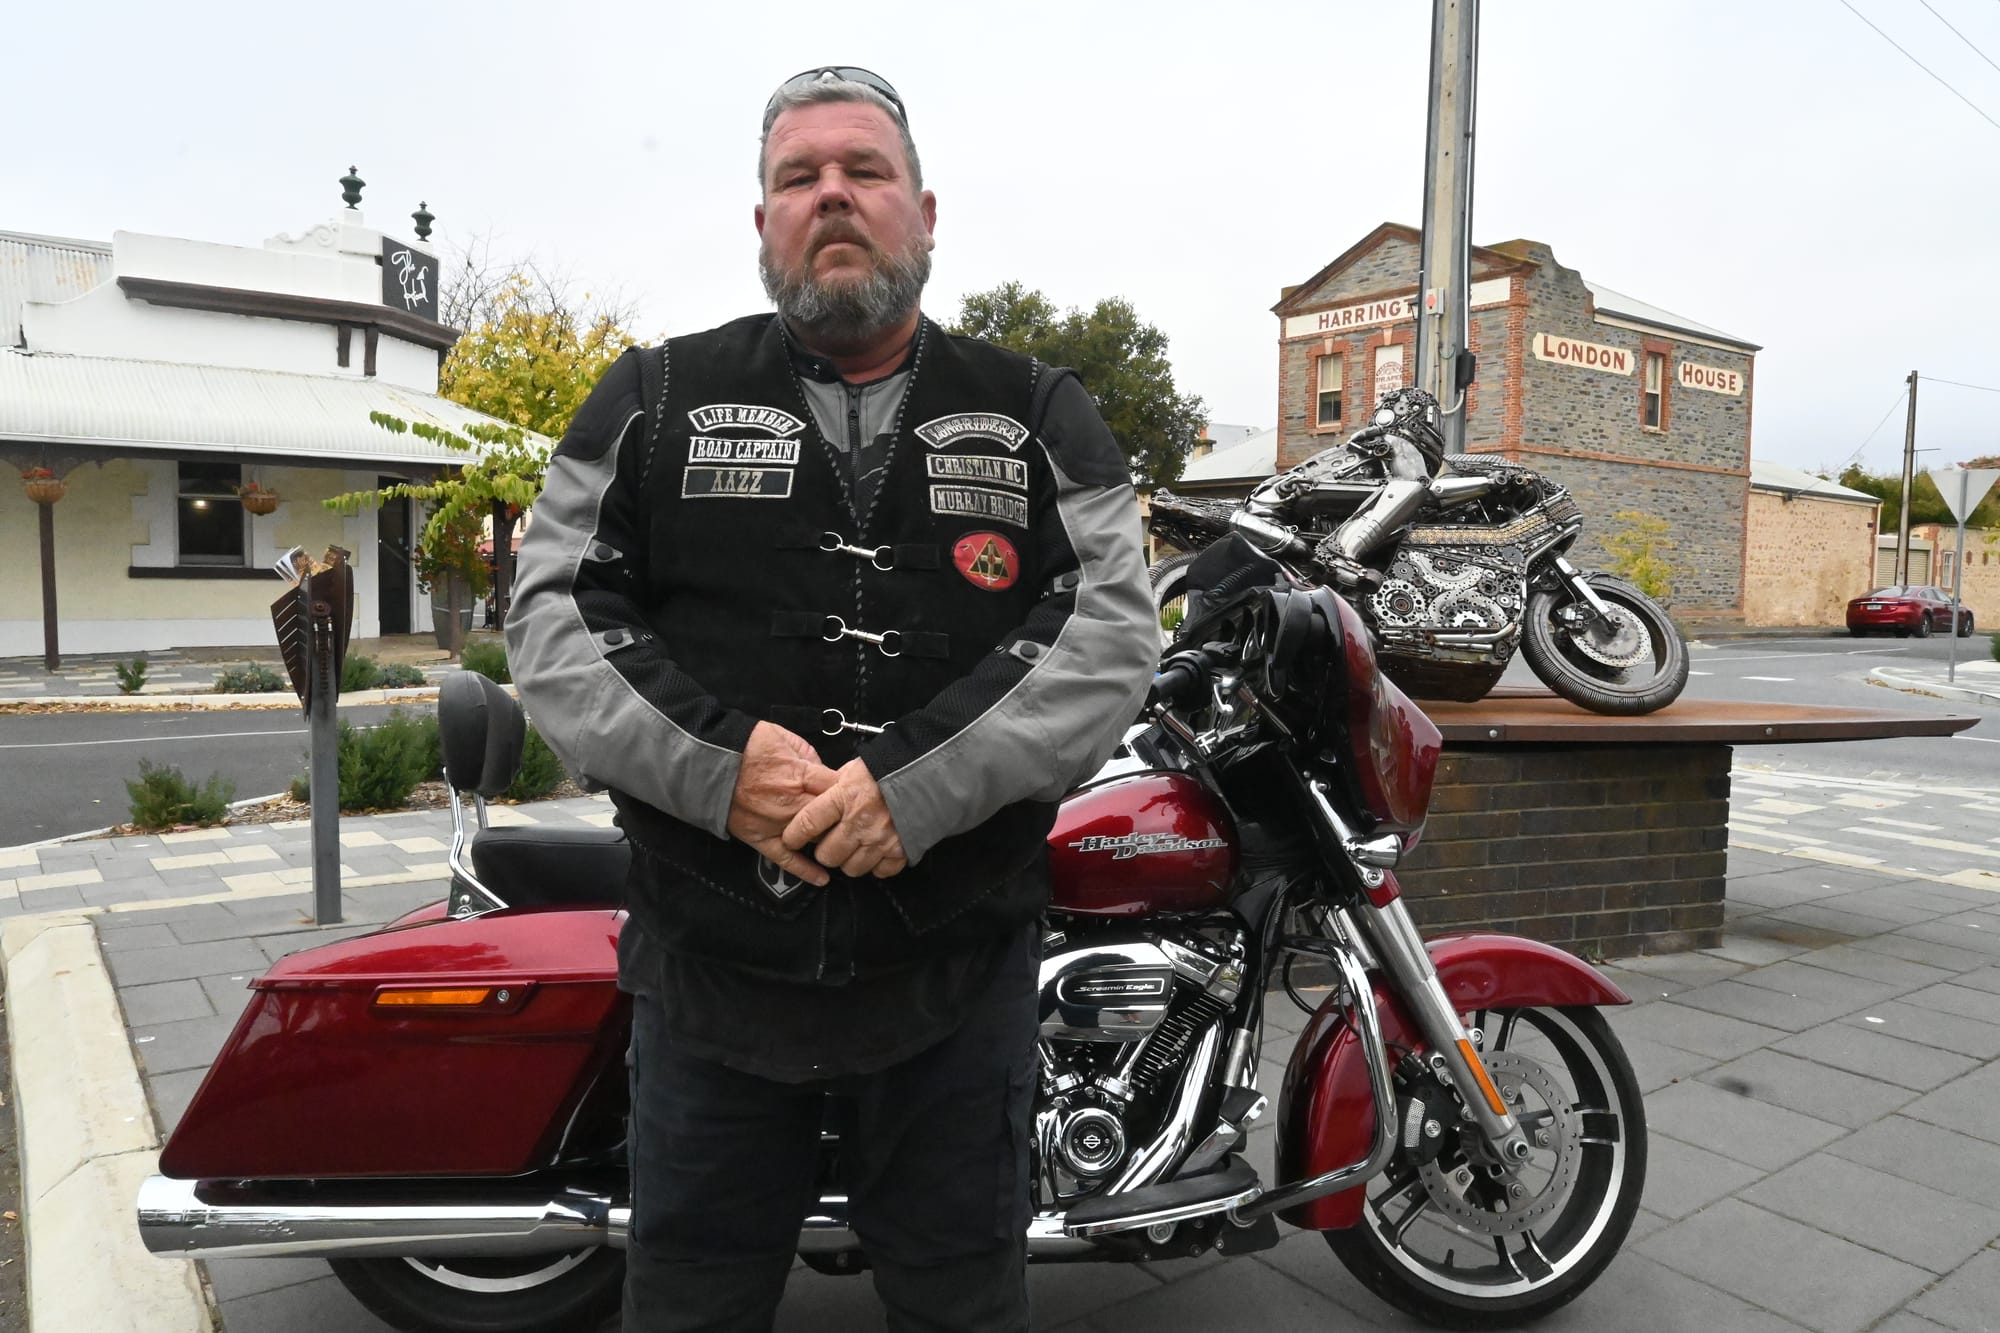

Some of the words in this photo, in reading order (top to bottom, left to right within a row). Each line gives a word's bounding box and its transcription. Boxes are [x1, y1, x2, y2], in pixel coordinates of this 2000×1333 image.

[1543, 335, 1625, 370] LONDON
[1682, 363, 1737, 391] HOUSE
[700, 408, 733, 426] LIFE
[737, 408, 794, 433] MEMBER
[927, 417, 1019, 441] LONGRIDERS
[696, 440, 732, 458] ROAD
[736, 442, 794, 460] CAPTAIN
[935, 458, 1001, 479] CHRISTIAN
[1005, 462, 1021, 483] MC
[936, 490, 987, 513] MURRAY
[990, 495, 1025, 522] BRIDGE
[1070, 832, 1179, 852] Harley
[1112, 838, 1228, 860] Davidson
[1126, 983, 1155, 991] Eagle
